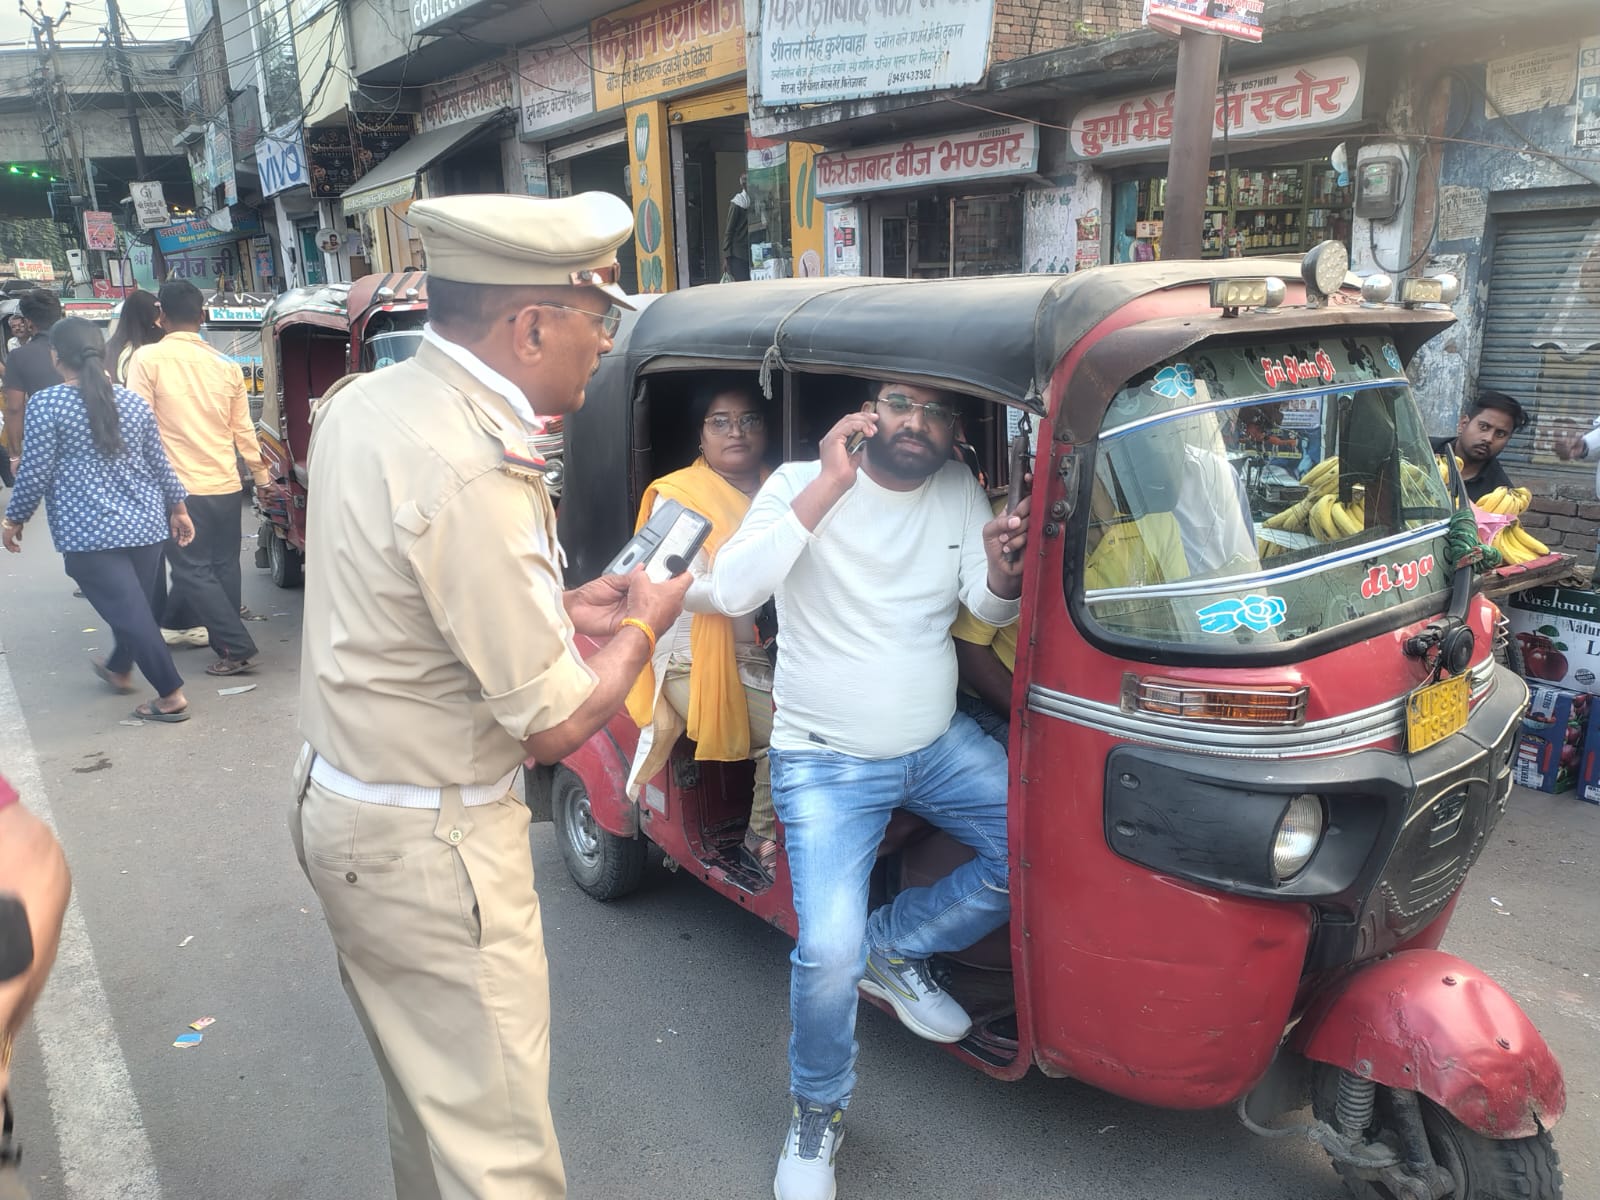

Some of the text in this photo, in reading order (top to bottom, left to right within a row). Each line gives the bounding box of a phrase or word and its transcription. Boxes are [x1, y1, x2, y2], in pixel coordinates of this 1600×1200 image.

[682, 46, 690, 67] के
[690, 43, 714, 67] विक्रेता
[771, 37, 802, 62] शीतल
[804, 32, 824, 61] सिंह
[825, 33, 867, 60] कुशवाहा
[942, 23, 965, 46] दुकान
[1081, 102, 1133, 156] दुर्गा
[1250, 69, 1349, 122] स्टोर
[257, 144, 301, 194] vivo
[817, 132, 1025, 190] फिरोजाबाद बीज भण्डार
[1261, 357, 1288, 389] Jai
[1283, 355, 1321, 384] Mata
[1518, 588, 1598, 615] Kashmir
